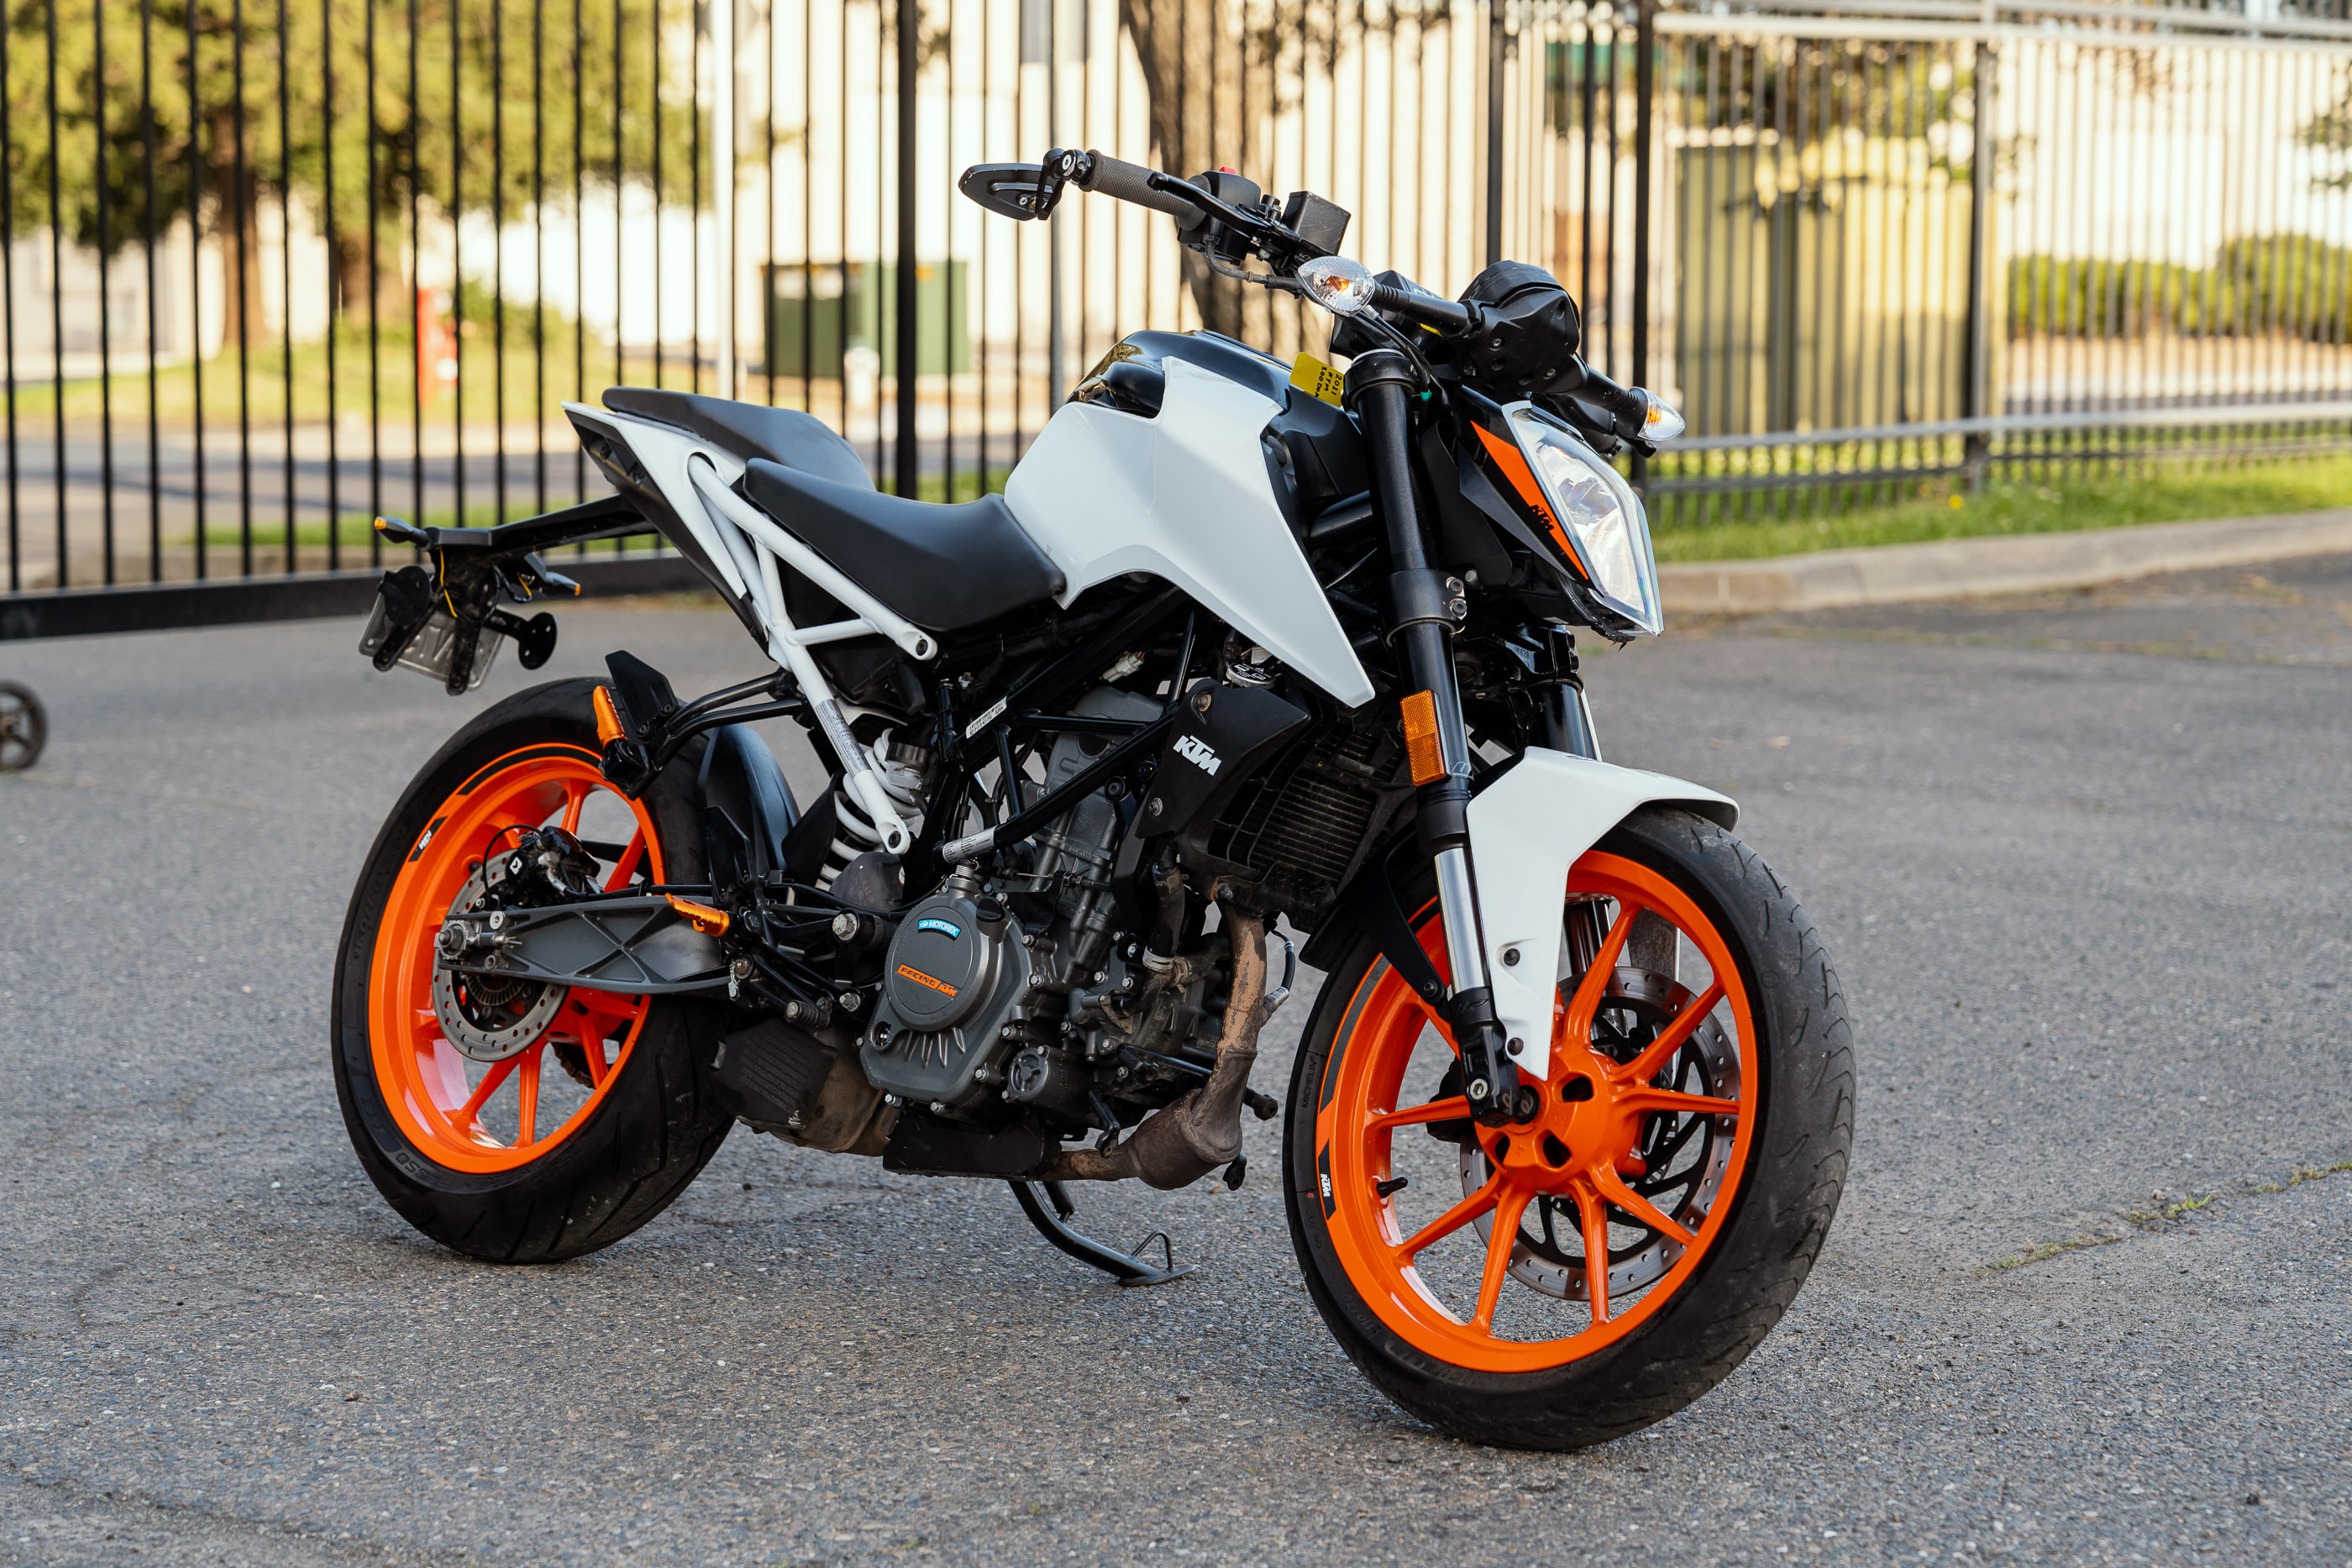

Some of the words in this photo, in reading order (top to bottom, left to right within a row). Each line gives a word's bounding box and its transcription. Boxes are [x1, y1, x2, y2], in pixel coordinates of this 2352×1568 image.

[1324, 371, 1333, 391] KTM
[1332, 374, 1342, 396] 2021
[1530, 505, 1555, 532] KTM
[1173, 735, 1222, 776] KTM
[928, 920, 958, 936] MOTOREX
[937, 983, 958, 997] KTM
[1302, 1060, 1318, 1108] MICHELIN
[1320, 1173, 1331, 1197] KTM
